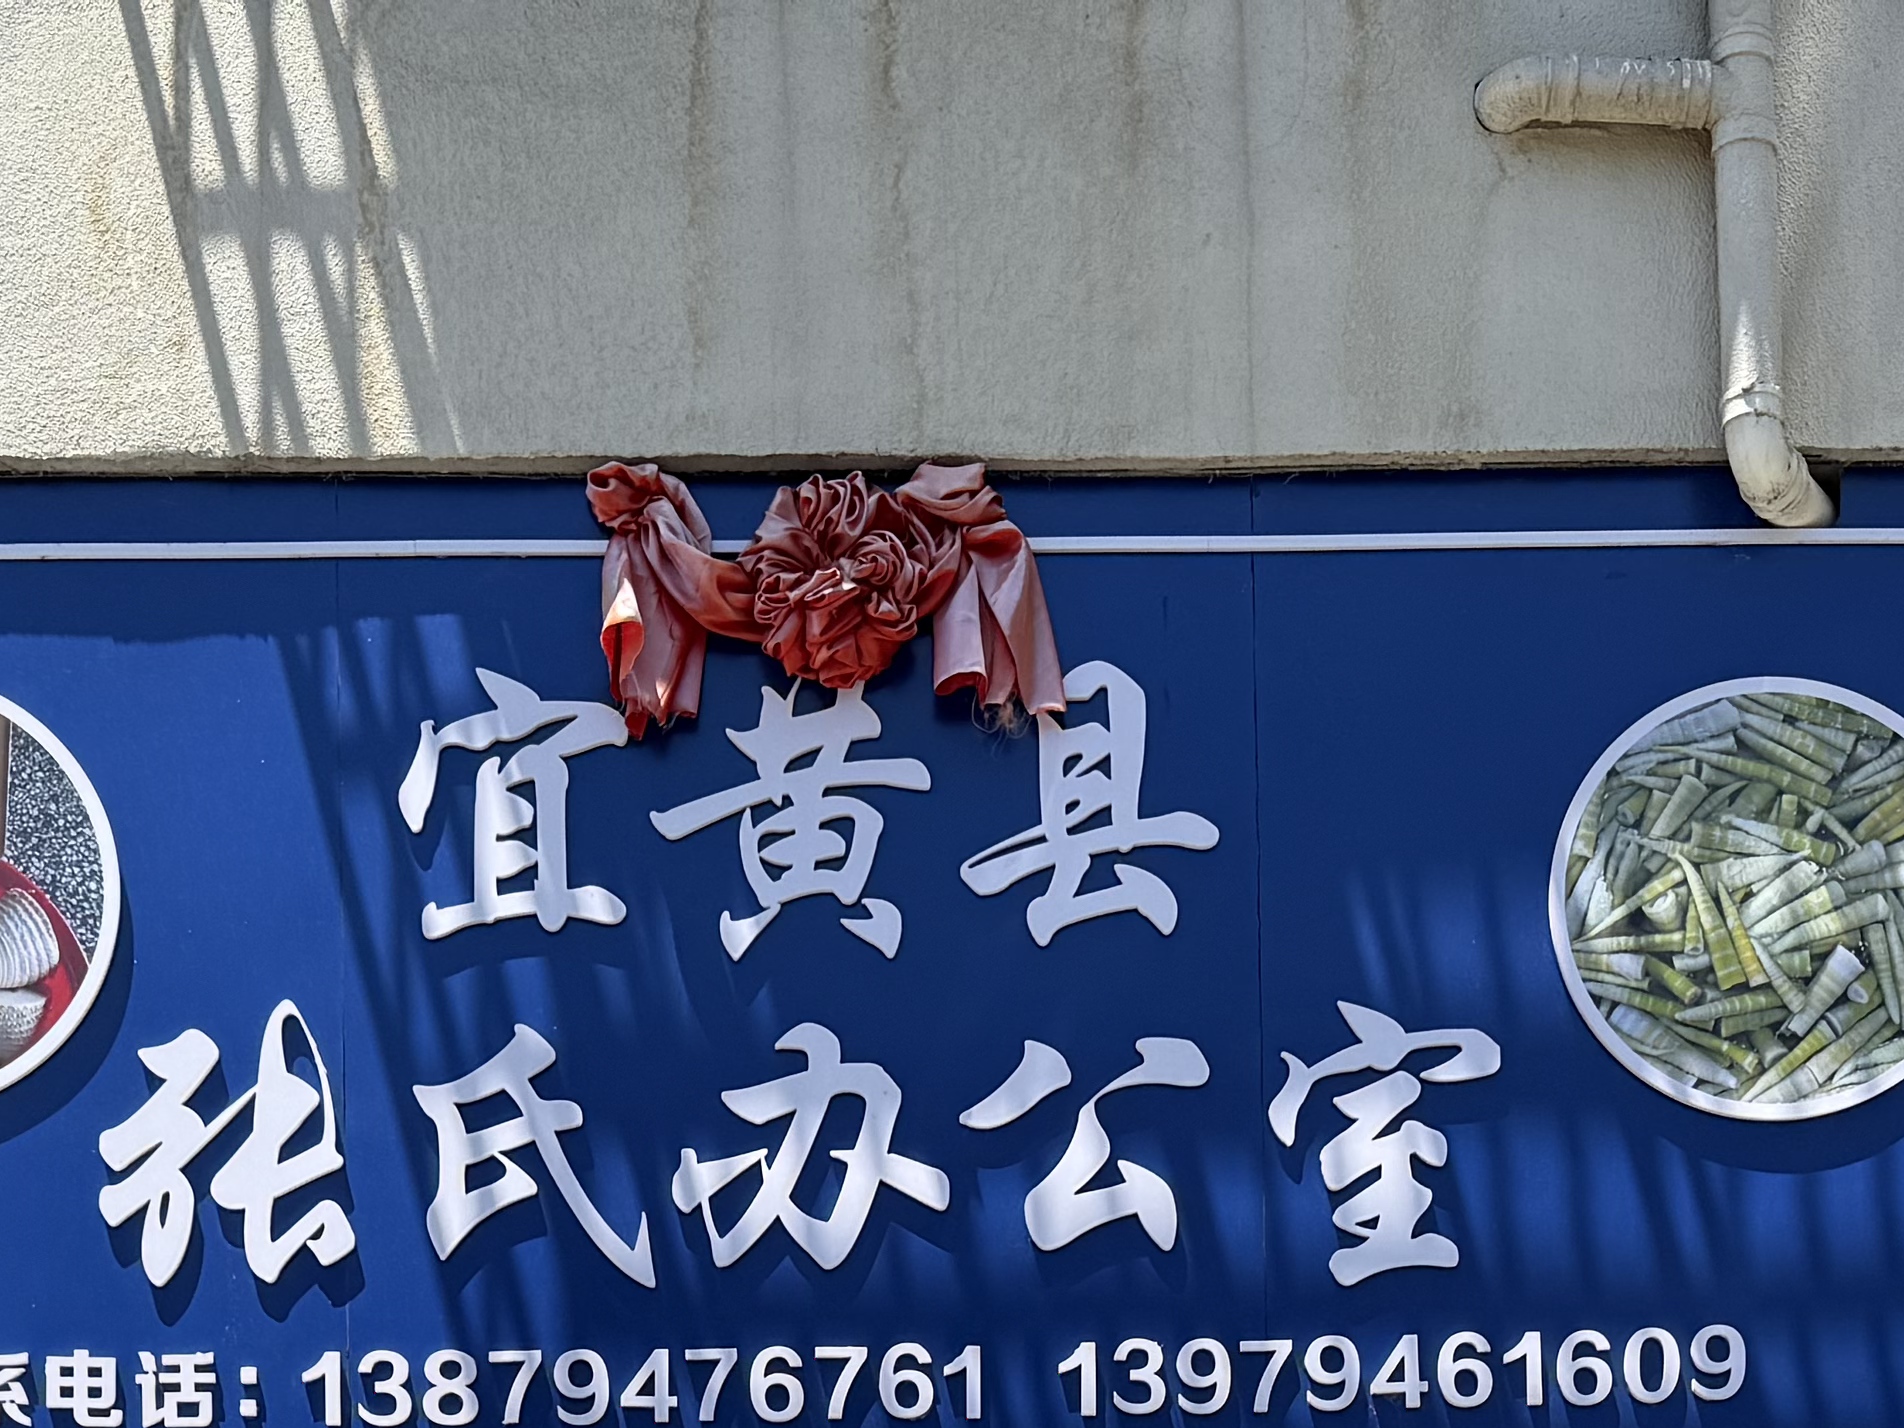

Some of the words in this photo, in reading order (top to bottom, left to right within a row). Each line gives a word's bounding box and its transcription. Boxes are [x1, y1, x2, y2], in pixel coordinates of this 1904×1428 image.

[399, 661, 1219, 961] 宜黄县
[99, 1000, 1501, 1287] 张氏办公室
[302, 1343, 980, 1428] 13879476761
[1058, 1325, 1745, 1418] 13979461609
